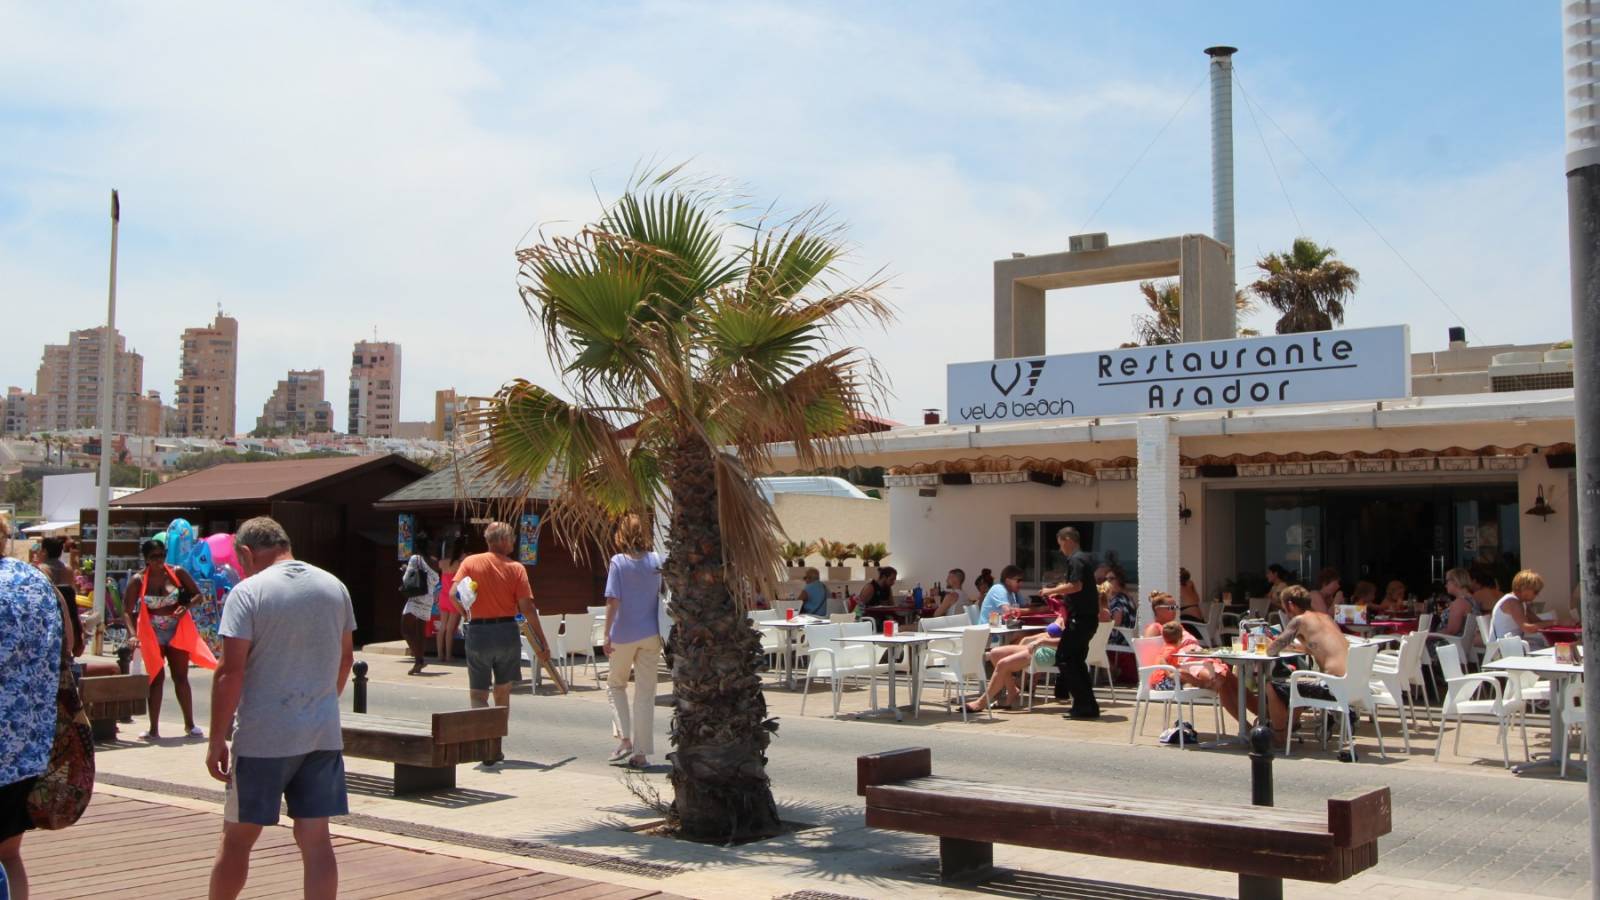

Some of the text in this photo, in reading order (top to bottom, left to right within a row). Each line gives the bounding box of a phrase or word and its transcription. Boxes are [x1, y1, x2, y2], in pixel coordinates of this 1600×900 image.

[1098, 337, 1353, 378] Restaurante
[1148, 379, 1290, 408] Asador
[960, 397, 1075, 420] vela beach
